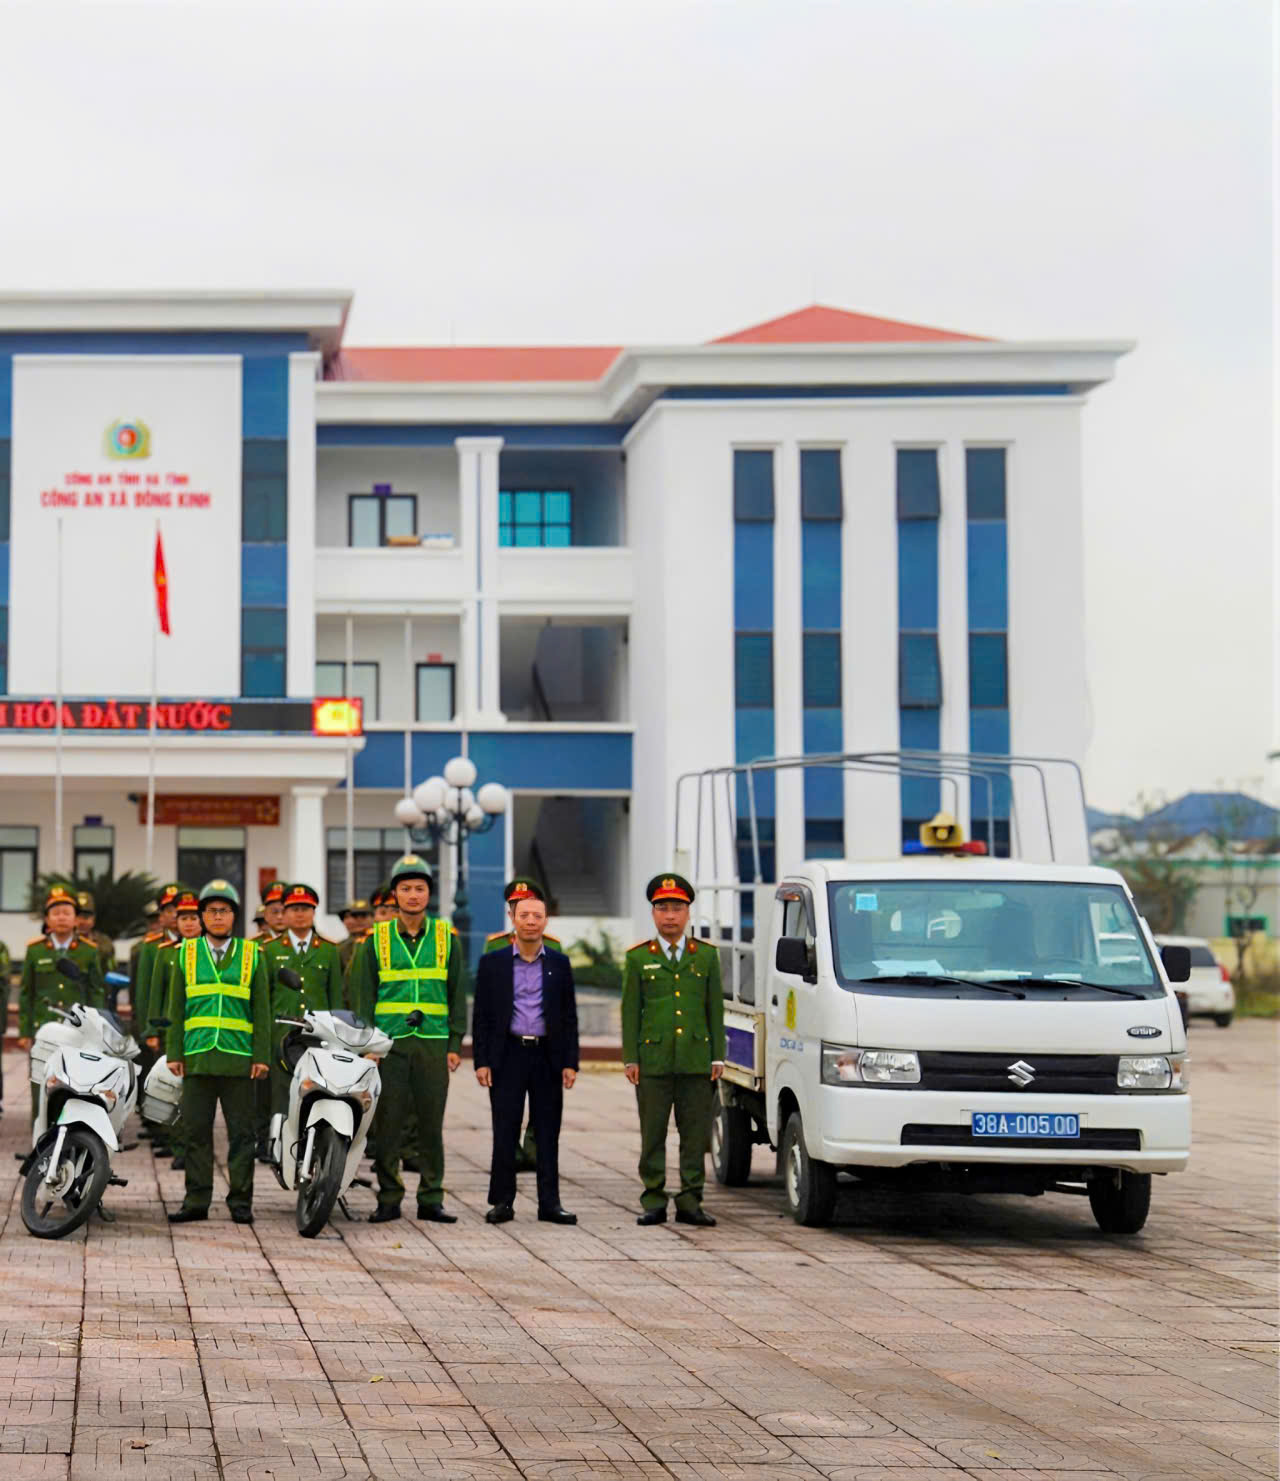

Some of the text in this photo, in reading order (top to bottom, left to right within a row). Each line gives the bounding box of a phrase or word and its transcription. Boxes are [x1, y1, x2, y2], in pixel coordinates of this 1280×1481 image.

[41, 487, 78, 507] CÔNG
[84, 491, 104, 507] AN
[177, 492, 211, 507] KINH
[13, 698, 76, 728] HÓA
[81, 699, 142, 728] ĐẤT
[145, 700, 232, 730] NƯỚC
[975, 1114, 1077, 1135] 38A-005.00
